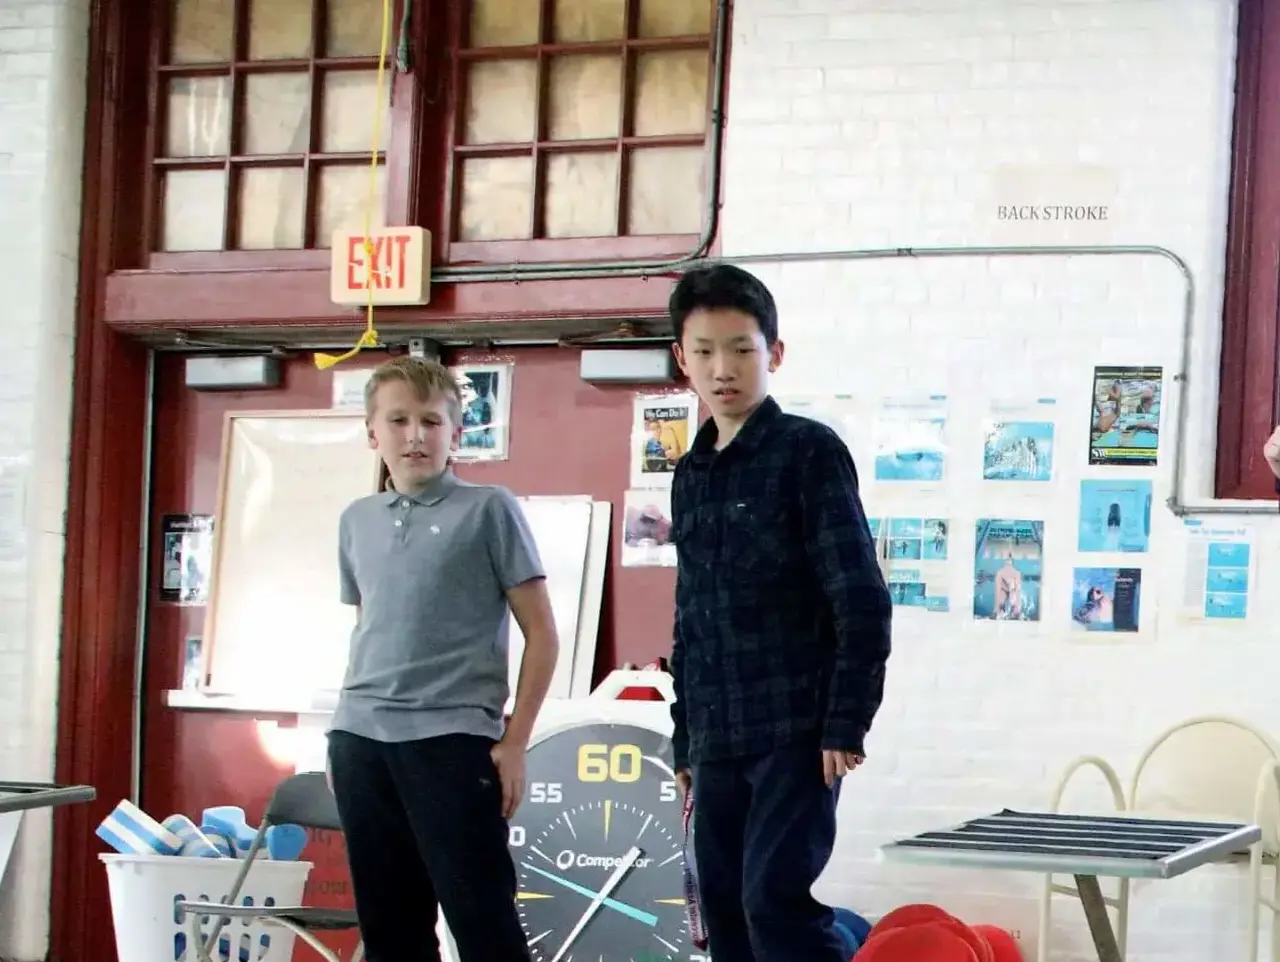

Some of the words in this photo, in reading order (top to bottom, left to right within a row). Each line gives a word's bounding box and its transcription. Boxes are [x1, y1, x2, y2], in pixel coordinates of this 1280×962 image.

[347, 235, 411, 290] EXIT
[656, 408, 669, 418] Can
[577, 743, 643, 783] 60
[529, 782, 563, 804] 55
[508, 825, 526, 847] 0
